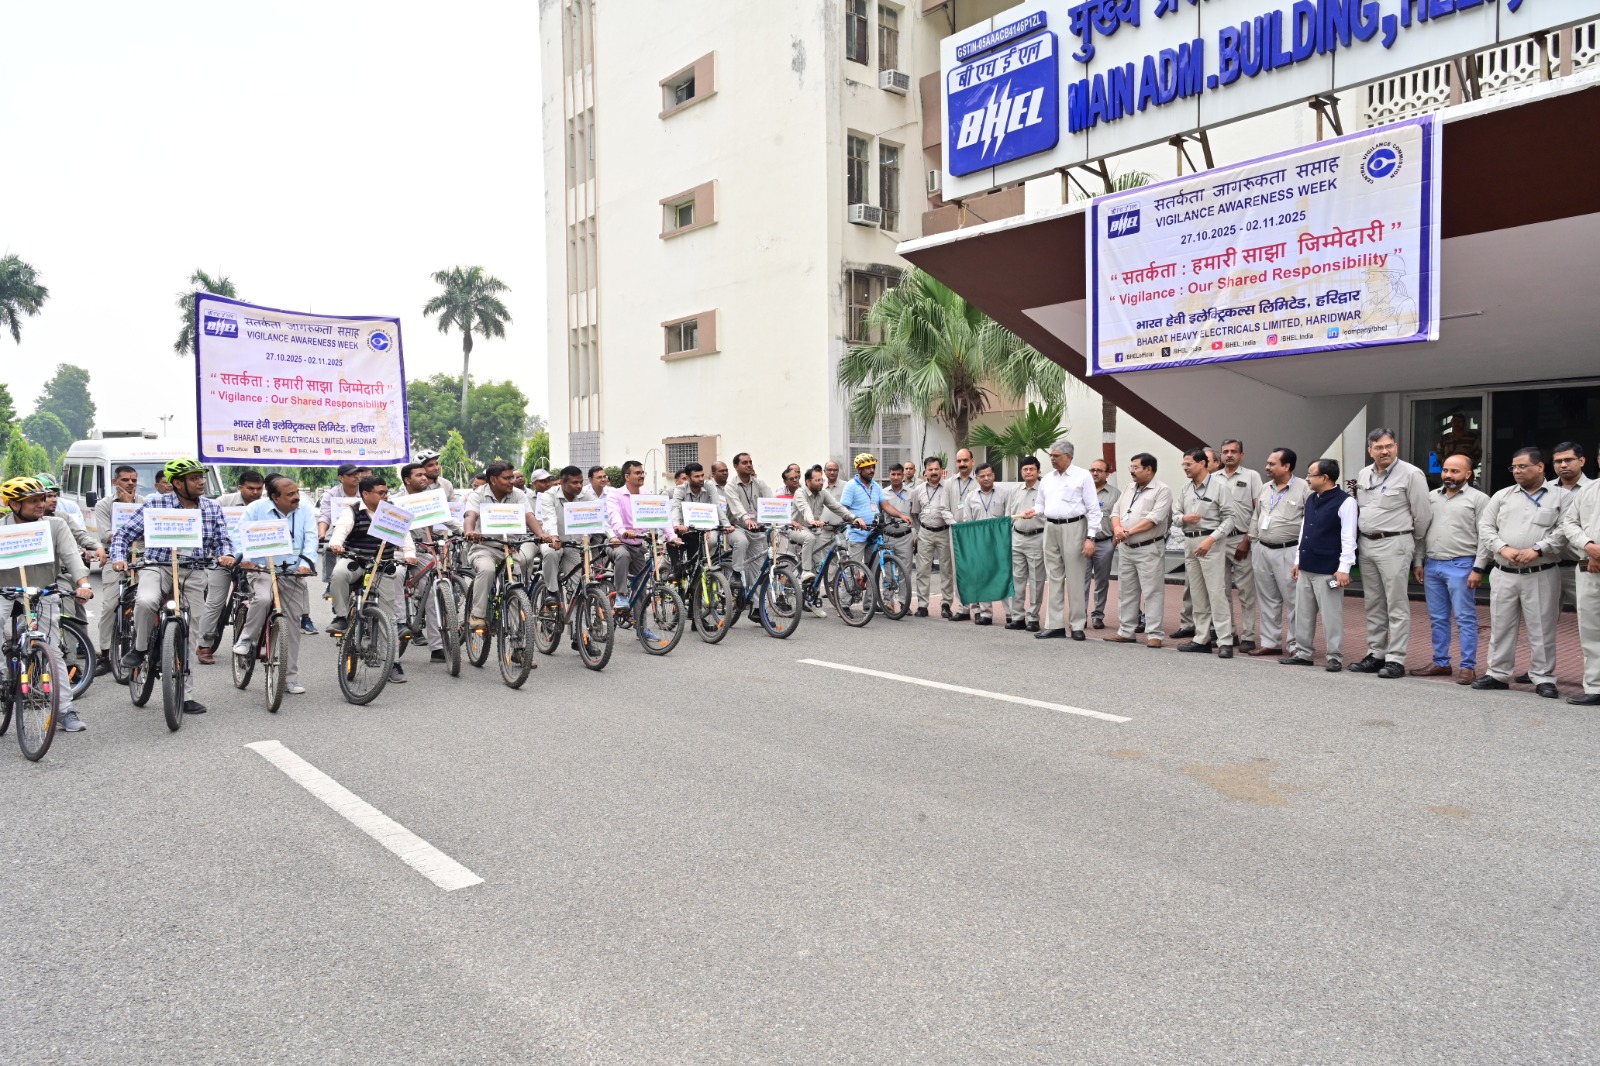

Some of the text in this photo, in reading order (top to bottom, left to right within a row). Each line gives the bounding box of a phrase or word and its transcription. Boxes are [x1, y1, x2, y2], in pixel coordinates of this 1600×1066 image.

[957, 14, 1042, 58] GSTIN-05AAACB4146P1ZL
[1068, 62, 1135, 134] MAIN
[956, 79, 1045, 160] BHEL
[1154, 188, 1205, 212] सतर्कता
[1212, 168, 1287, 197] जागरूकता
[1295, 156, 1340, 179] सप्ताह
[1155, 205, 1214, 228] VIGILANCE
[1218, 187, 1294, 215] AWARENESS
[1298, 177, 1338, 197] WEEK
[1110, 213, 1138, 236] BHEL
[1180, 224, 1236, 245] 27.10.2025
[1245, 210, 1306, 232] 02.11.2025
[1122, 261, 1177, 285] सतर्कता
[1191, 247, 1238, 275] हमारी
[1242, 242, 1287, 264] साझा
[1297, 219, 1385, 255] जिम्मेदारी
[1119, 288, 1175, 306] Vigilance
[1188, 281, 1213, 294] Our
[1217, 270, 1267, 290] Shared
[1272, 253, 1388, 280] Responsibility
[207, 319, 237, 336] BHEL
[244, 317, 282, 330] सतर्कता
[1136, 317, 1163, 330] भारत
[1166, 311, 1186, 327] हेवी
[1316, 289, 1361, 307] हरिद्वार
[247, 330, 289, 343] VIGILANCE
[291, 335, 337, 348] AWARENESS
[338, 340, 359, 350] WEEK
[1136, 334, 1168, 347] BHARAT
[1170, 331, 1198, 342] HEAVY
[1200, 322, 1260, 339] ELECTRICALS
[1306, 310, 1361, 326] HARIDWAR
[266, 352, 303, 364] 27.10.2025
[308, 356, 343, 367] 02.11.2025
[218, 390, 262, 403] Vigilance
[271, 394, 288, 404] Our
[290, 395, 322, 406] Shared
[325, 398, 387, 410] Responsibility
[220, 370, 263, 387] सतर्कता
[273, 375, 304, 390] हमारी
[306, 380, 333, 394] साझा
[339, 378, 384, 396] जिम्मेदारी
[233, 433, 258, 442] BHARAT
[260, 435, 279, 443] HEAVY
[280, 435, 320, 444] ELECTRICALS
[346, 437, 377, 445] HARIDWAR
